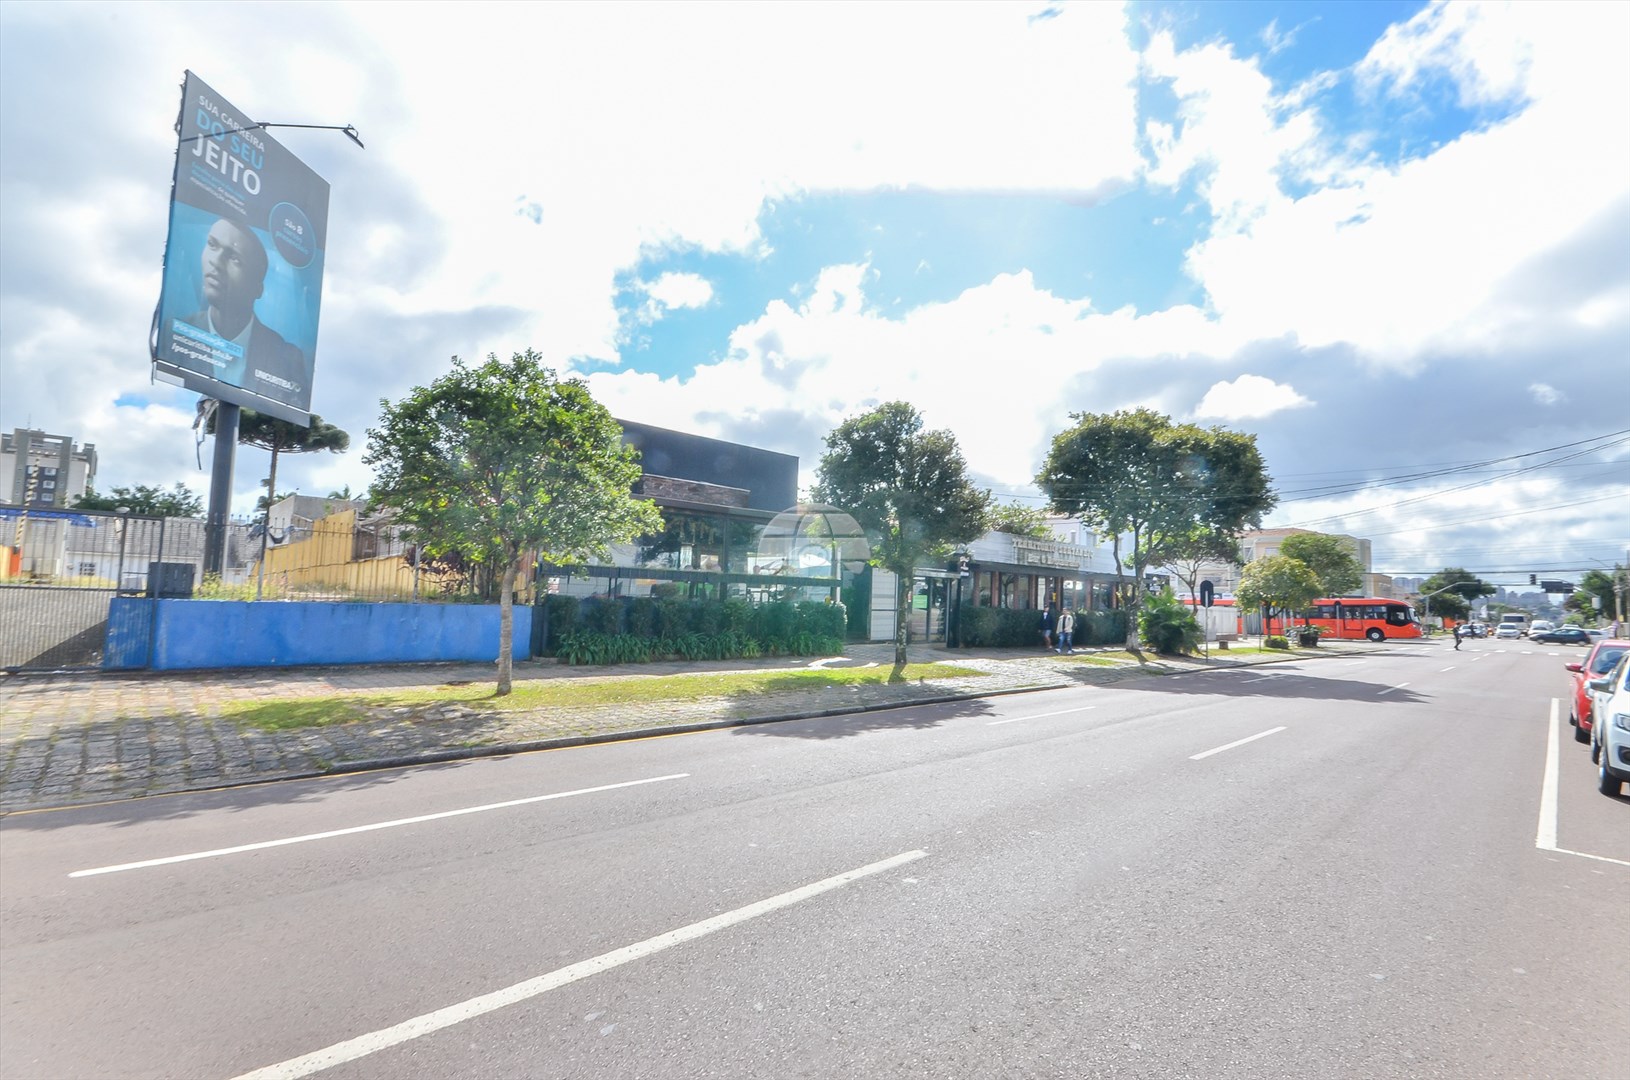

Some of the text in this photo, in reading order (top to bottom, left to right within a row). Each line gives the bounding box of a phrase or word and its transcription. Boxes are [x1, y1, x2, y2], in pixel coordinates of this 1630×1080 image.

[196, 108, 264, 170] DO SEU
[199, 95, 265, 152] SUA CARREIRA
[192, 133, 261, 195] JEITO
